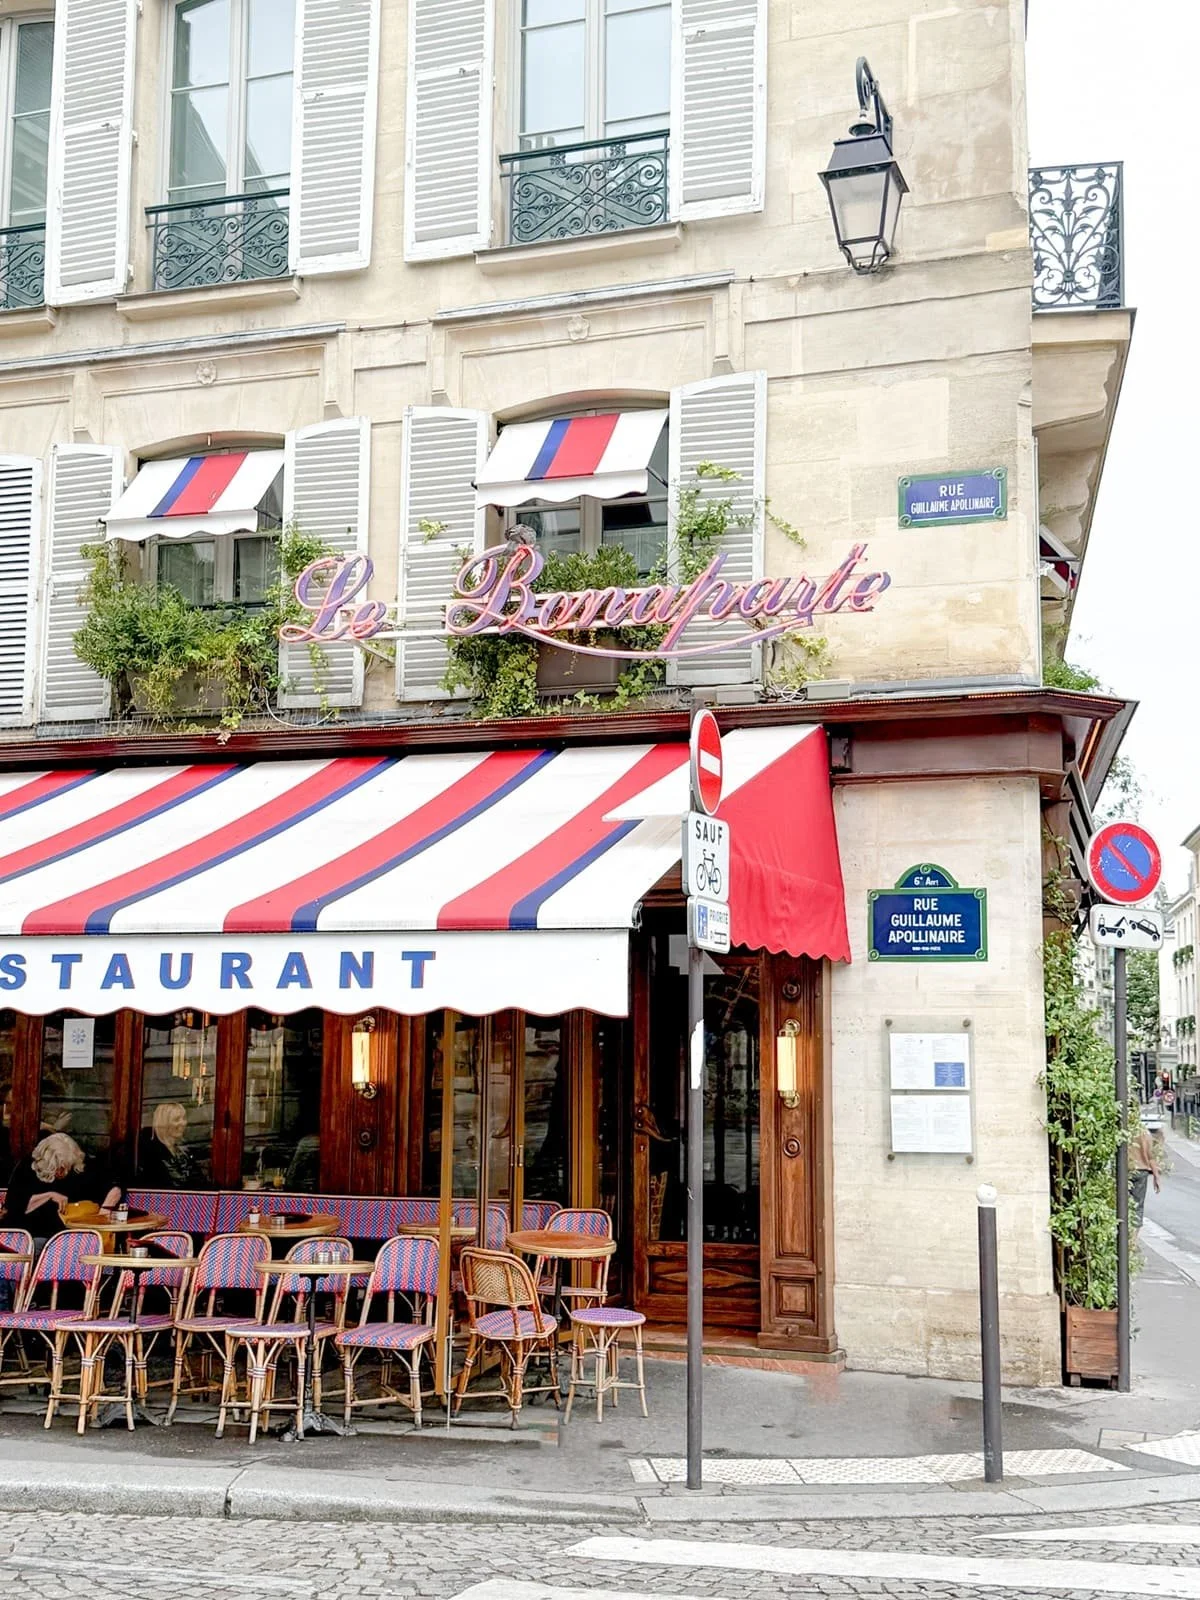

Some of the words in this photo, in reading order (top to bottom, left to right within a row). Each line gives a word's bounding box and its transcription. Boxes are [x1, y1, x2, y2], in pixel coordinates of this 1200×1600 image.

[939, 483, 965, 497] RUE
[910, 500, 949, 515] GUILLAUME
[950, 496, 996, 511] APOLLINAIRE
[279, 554, 387, 643] Le
[444, 542, 891, 660] Bonaparte
[695, 819, 723, 846] SAUF
[913, 898, 939, 911] RUE
[890, 914, 962, 927] GUILLAUME
[888, 930, 966, 943] APOLLINAIRE
[0, 951, 437, 990] STAURANT
